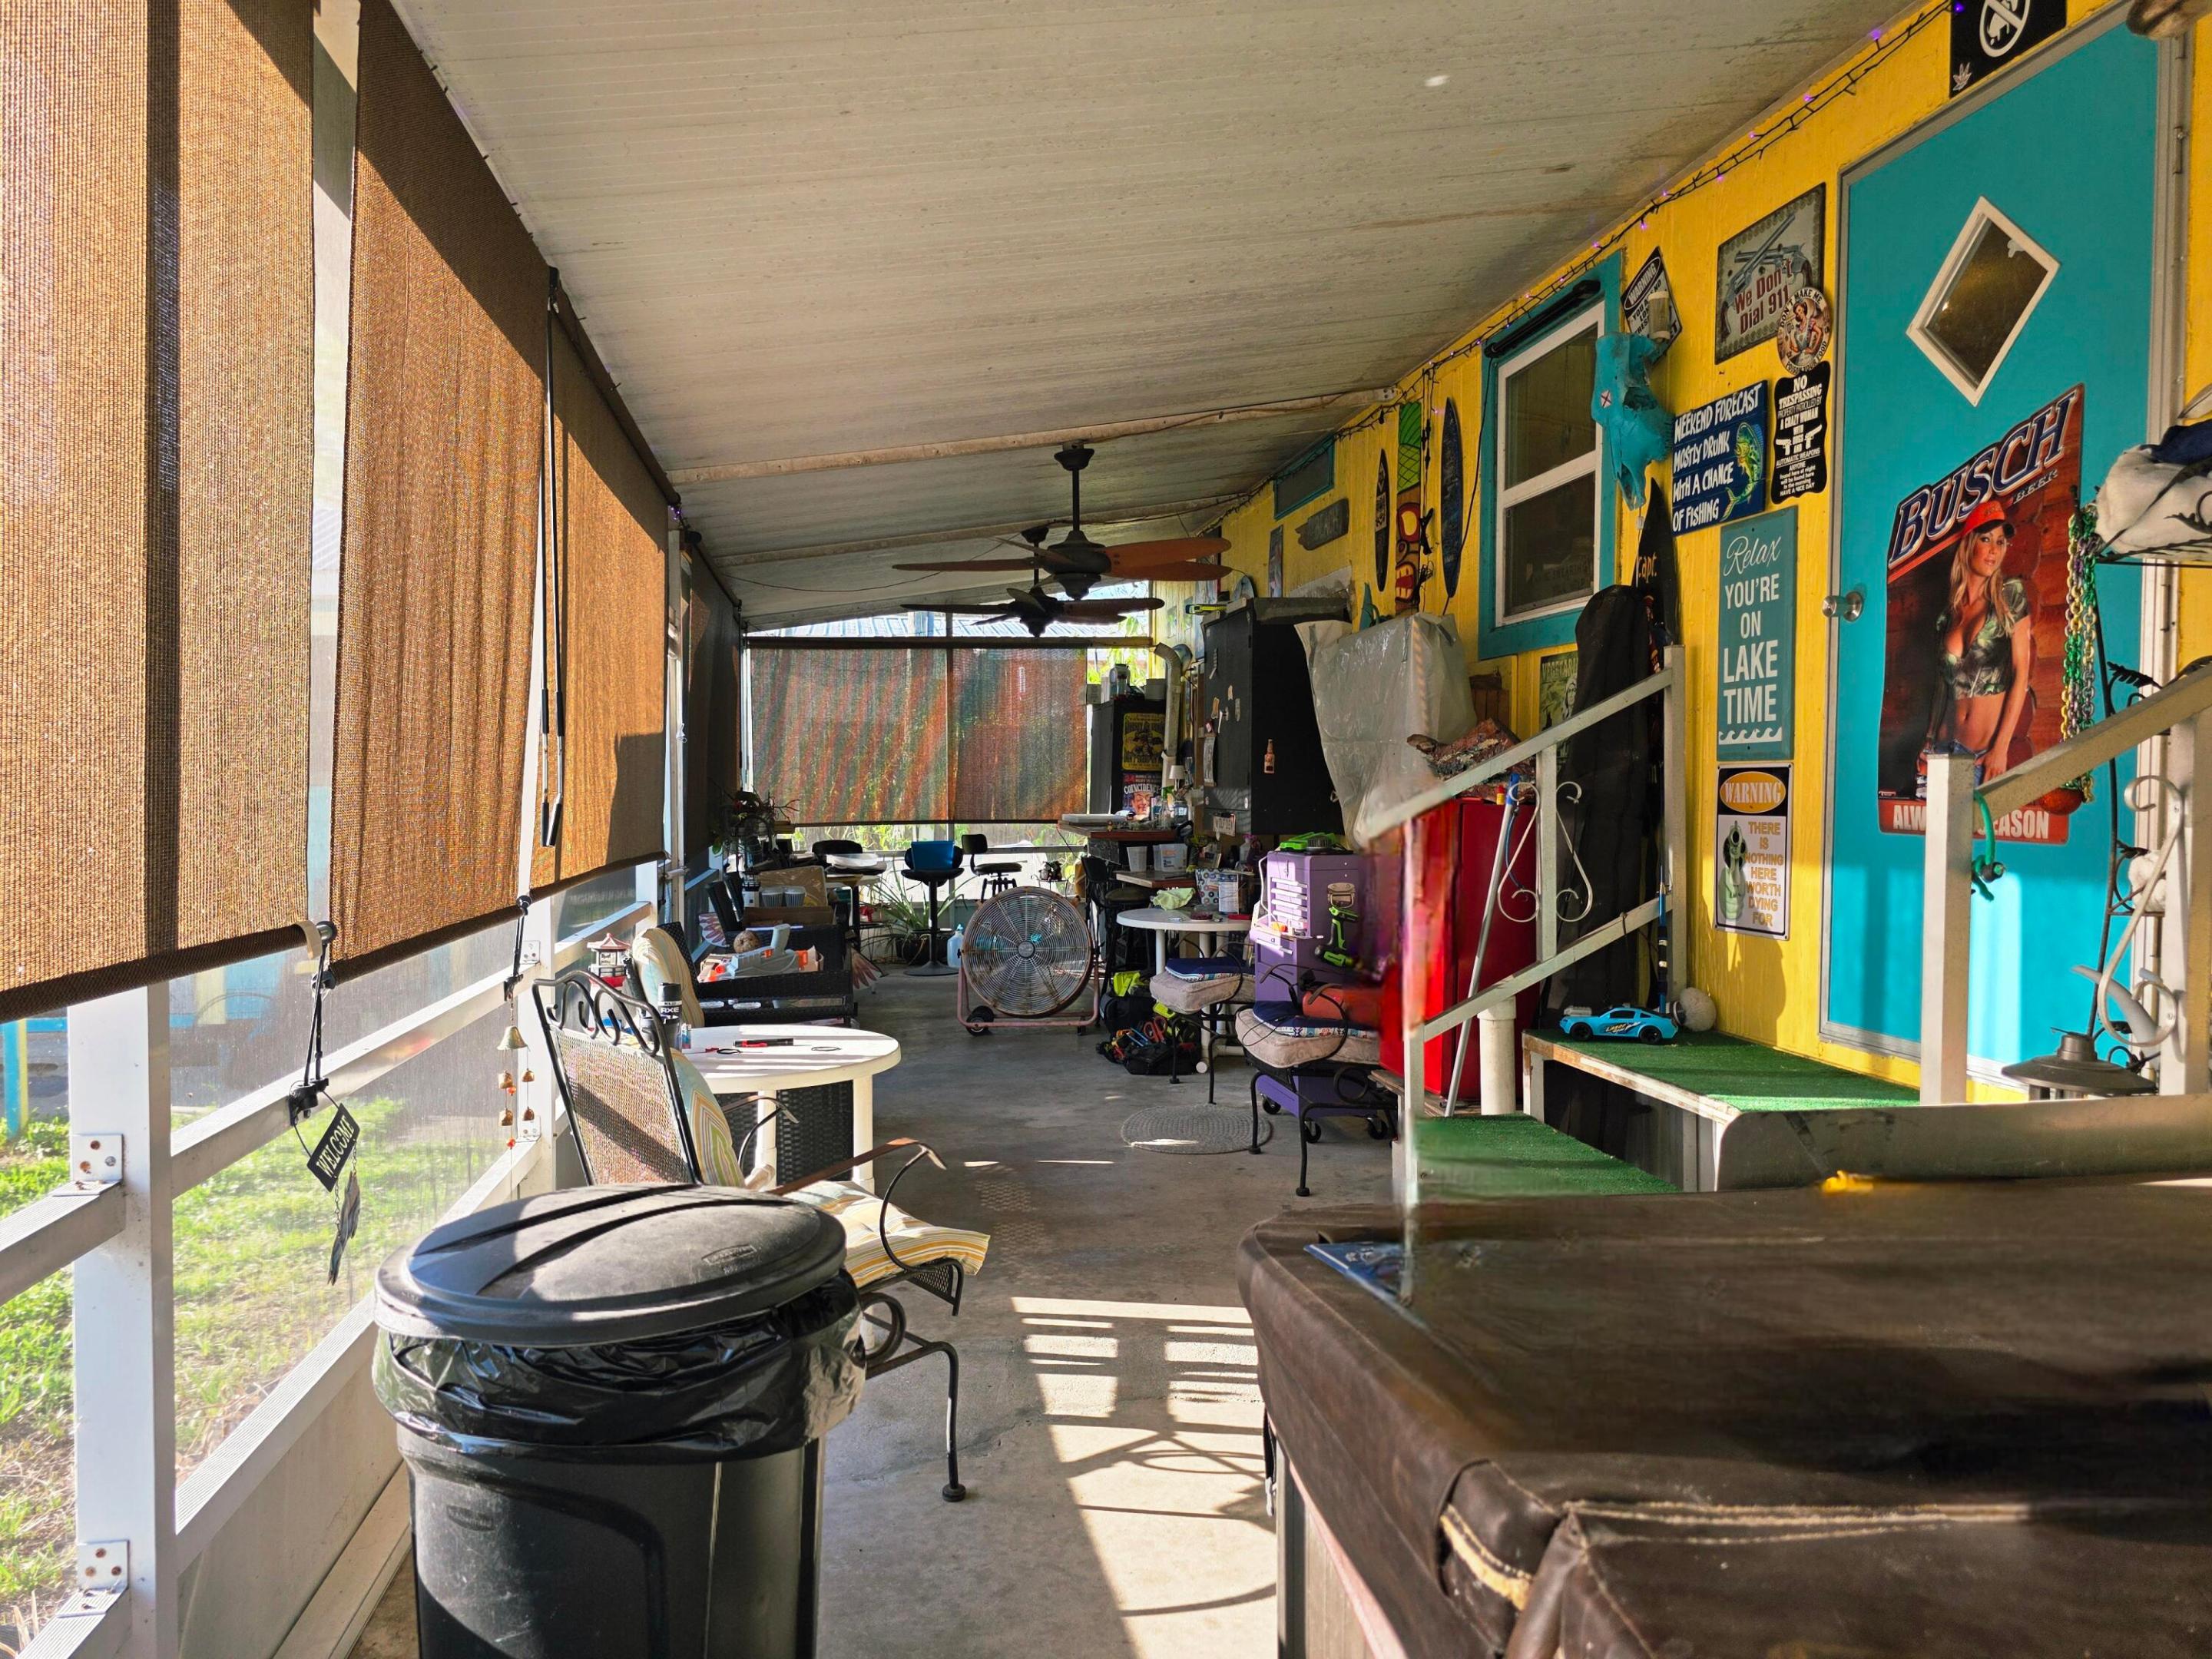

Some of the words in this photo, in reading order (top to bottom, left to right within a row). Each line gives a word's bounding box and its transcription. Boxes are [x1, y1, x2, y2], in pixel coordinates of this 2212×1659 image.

[1628, 263, 1657, 306] WARNING
[1735, 290, 1752, 314] We
[1757, 257, 1793, 300] Don't
[1794, 288, 1812, 300] MAKE
[1813, 290, 1823, 305] ME
[1633, 304, 1644, 320] YOU
[1740, 300, 1763, 335] Dial
[1769, 284, 1789, 315] 911
[1816, 341, 1827, 359] FOOD
[1779, 383, 1823, 409] TRESPASSING
[1793, 375, 1808, 392] NO
[1674, 406, 1713, 444] WEEKEND
[1714, 382, 1762, 426] FORECAST
[1780, 418, 1784, 430] A
[1784, 413, 1799, 429] CRAZY
[1800, 406, 1819, 423] WOMAN
[1674, 442, 1703, 474] MOSTLY
[1703, 430, 1730, 459] DRUNK
[1777, 454, 1799, 467] AUTOMATIC
[1800, 447, 1820, 459] WEAPONS
[1789, 461, 1806, 472] ANYONE
[1888, 387, 2079, 570] BUSCH
[1673, 475, 1690, 503] WITH
[1692, 473, 1700, 495] A
[1702, 462, 1734, 492] CHANCE
[2013, 469, 2058, 503] BEER
[1673, 508, 1684, 532] OF
[1686, 498, 1719, 528] FISHING
[1724, 535, 1781, 577] Relax
[1725, 573, 1780, 609] YOU'RE
[1740, 611, 1761, 639] ON
[1724, 640, 1778, 684] LAKE
[1724, 684, 1777, 724] TIME
[1724, 782, 1781, 804] WARNING
[1748, 821, 1781, 835] THERE
[1892, 804, 1926, 832] ALW
[1760, 837, 1769, 849] IS
[1745, 853, 1783, 866] NOTHING
[1750, 867, 1777, 881] HERE
[1747, 881, 1781, 896] WORTH
[1748, 897, 1778, 911] DYING
[1753, 912, 1773, 926] FOR
[316, 1115, 356, 1177] WELCOME
